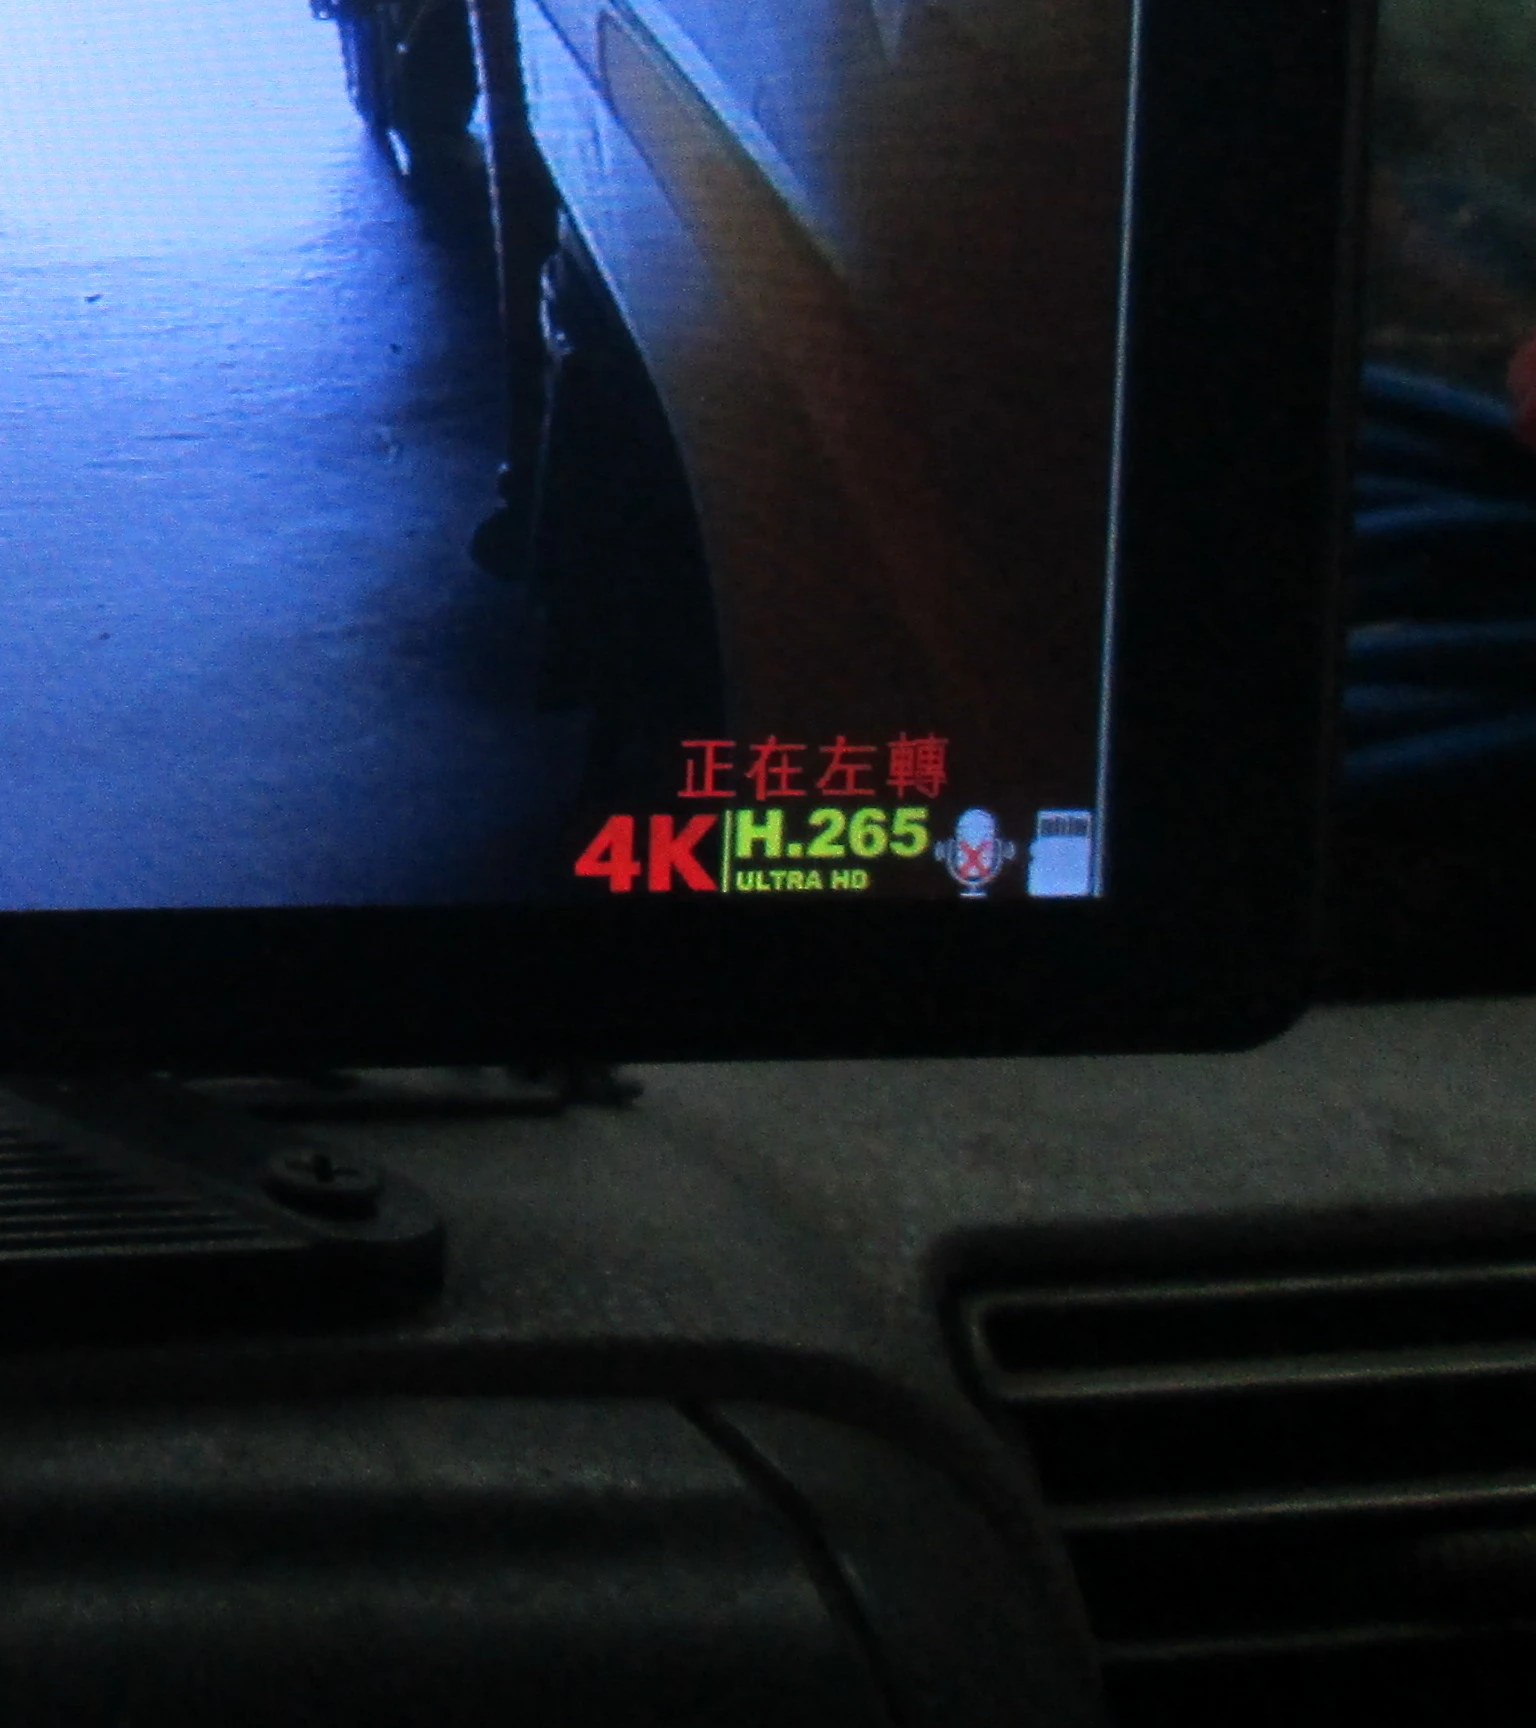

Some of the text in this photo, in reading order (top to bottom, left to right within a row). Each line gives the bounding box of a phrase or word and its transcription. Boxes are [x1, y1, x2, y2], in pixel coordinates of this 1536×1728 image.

[677, 731, 950, 801] 正在左轉
[575, 813, 718, 893] 4K
[735, 807, 929, 859] H.265
[736, 869, 868, 891] ULTRA HD
